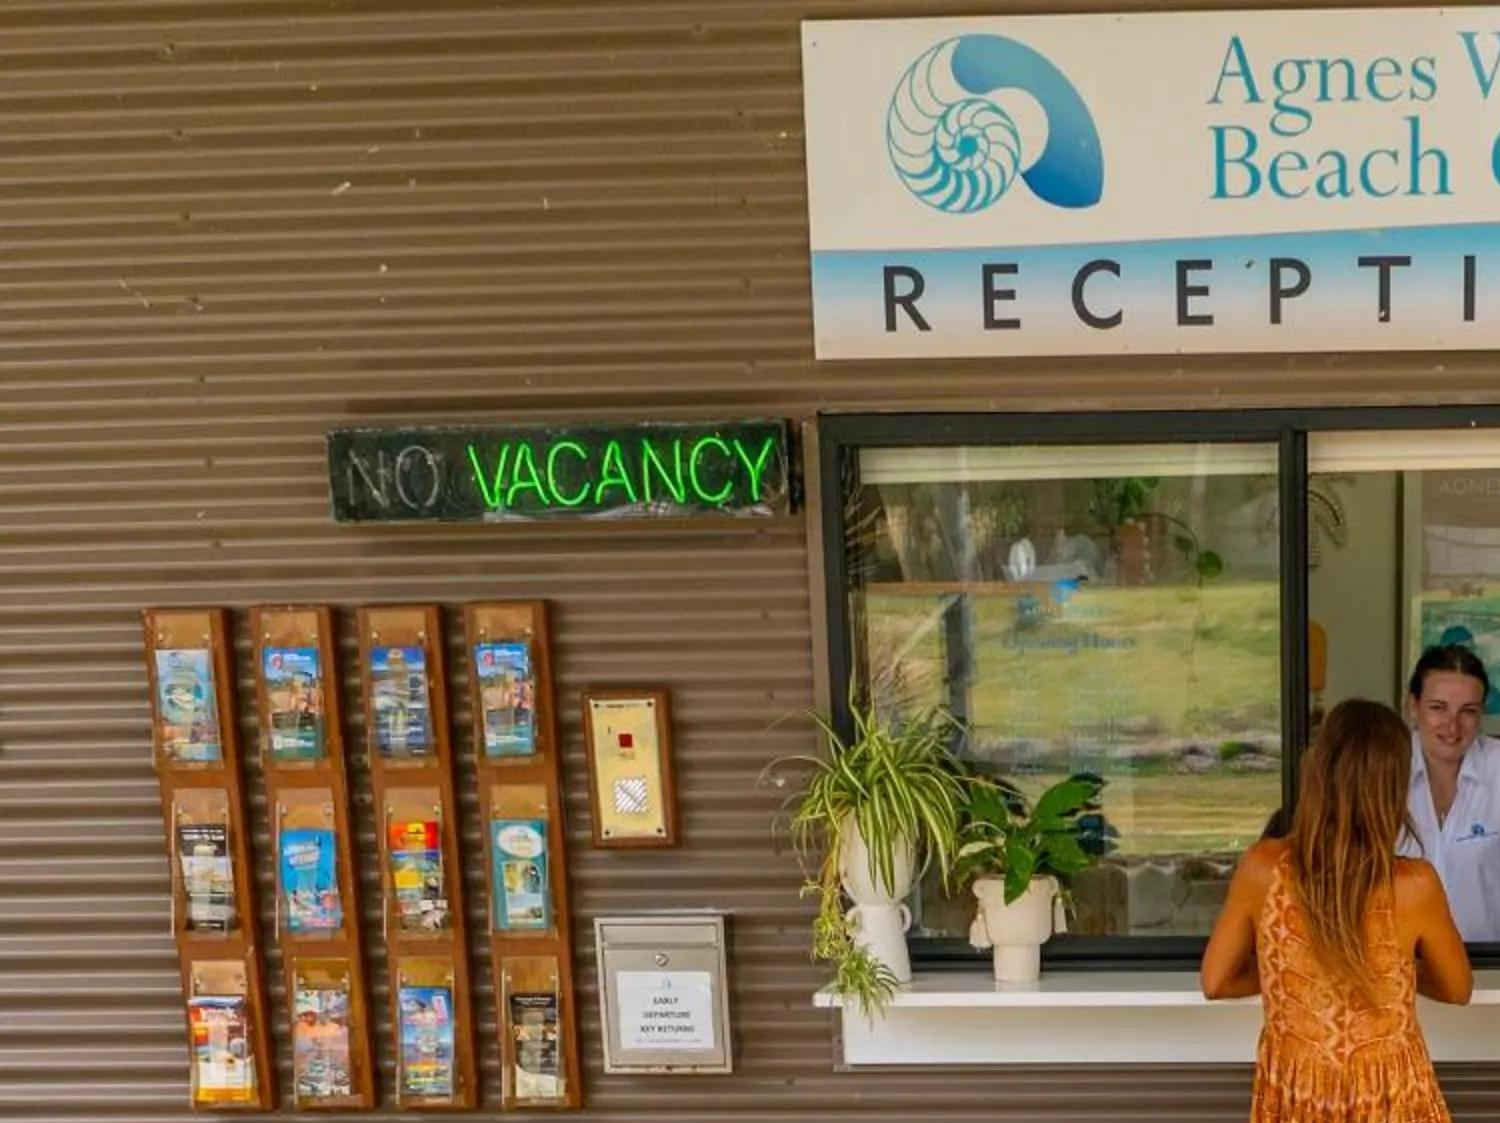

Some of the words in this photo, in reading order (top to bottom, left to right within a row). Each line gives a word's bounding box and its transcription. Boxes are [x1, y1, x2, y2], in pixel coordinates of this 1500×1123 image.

[1206, 34, 1438, 136] Agnes
[1208, 113, 1452, 200] Beach
[347, 444, 439, 508] NO
[467, 436, 774, 509] VACANCY
